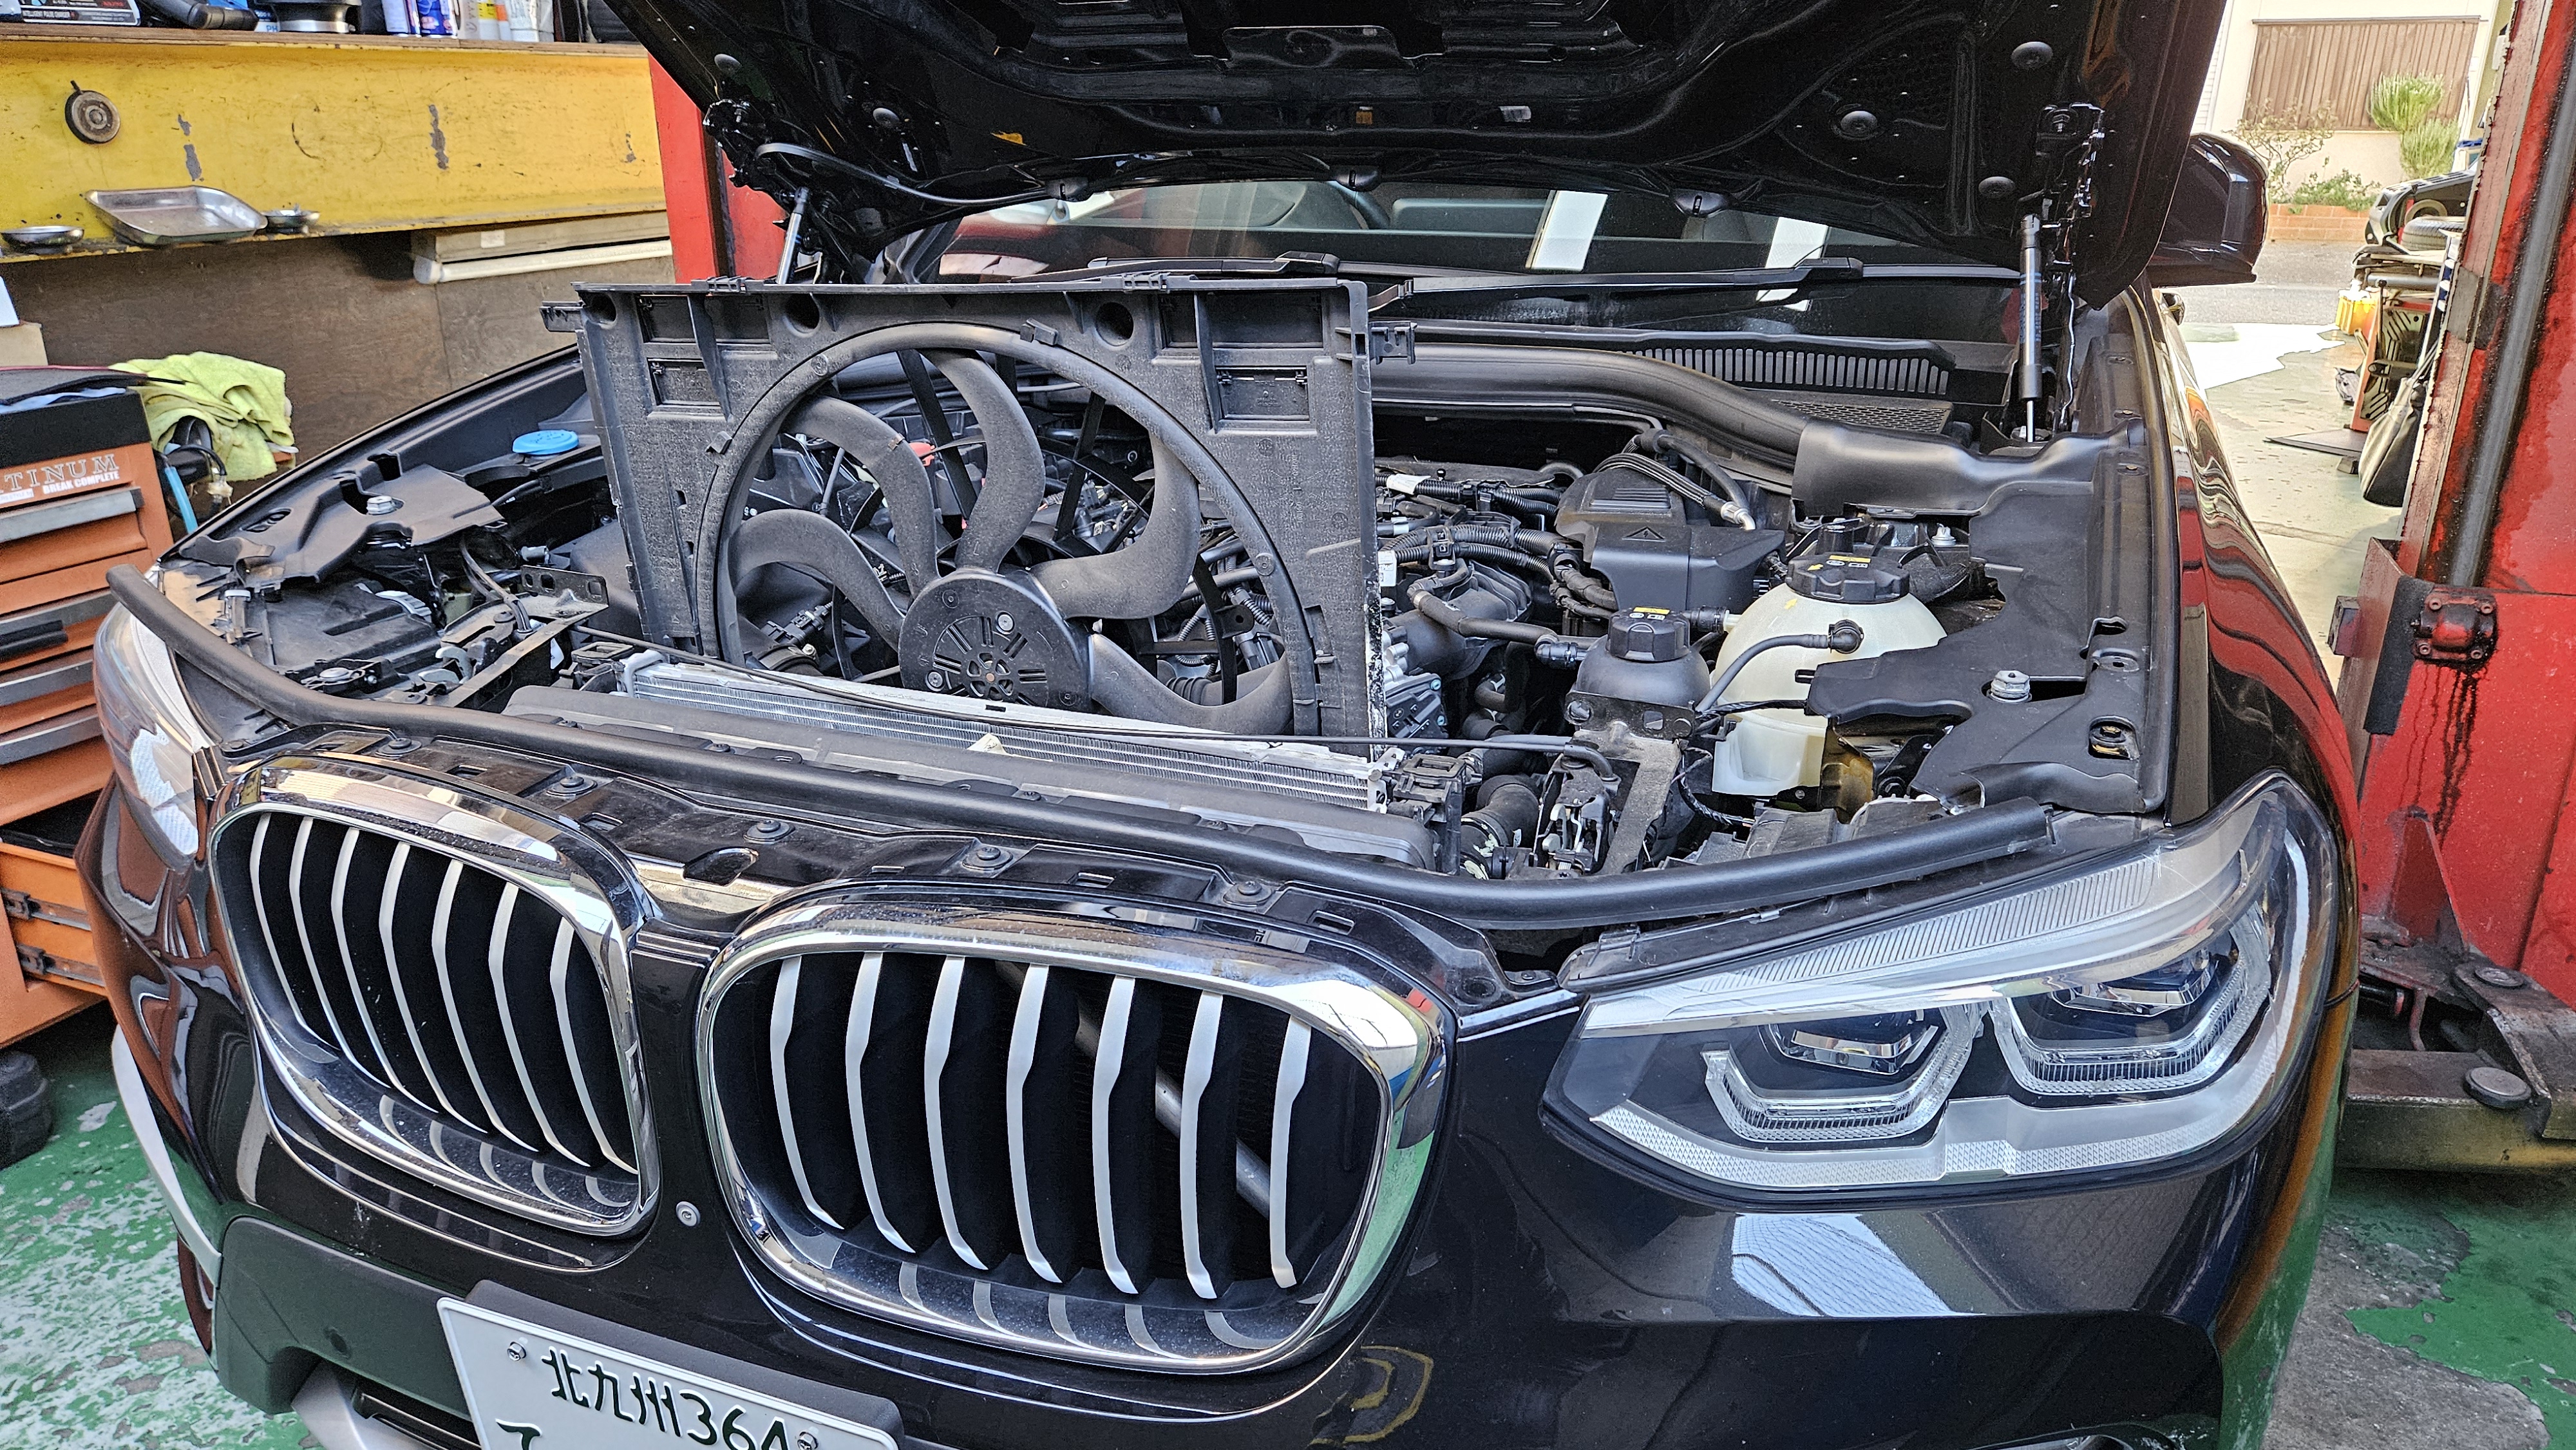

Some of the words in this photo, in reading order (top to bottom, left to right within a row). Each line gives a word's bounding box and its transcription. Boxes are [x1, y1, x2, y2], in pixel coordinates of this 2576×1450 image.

[0, 453, 119, 494] TINUM
[43, 480, 73, 494] BREAK
[75, 471, 120, 488] COMPLETE
